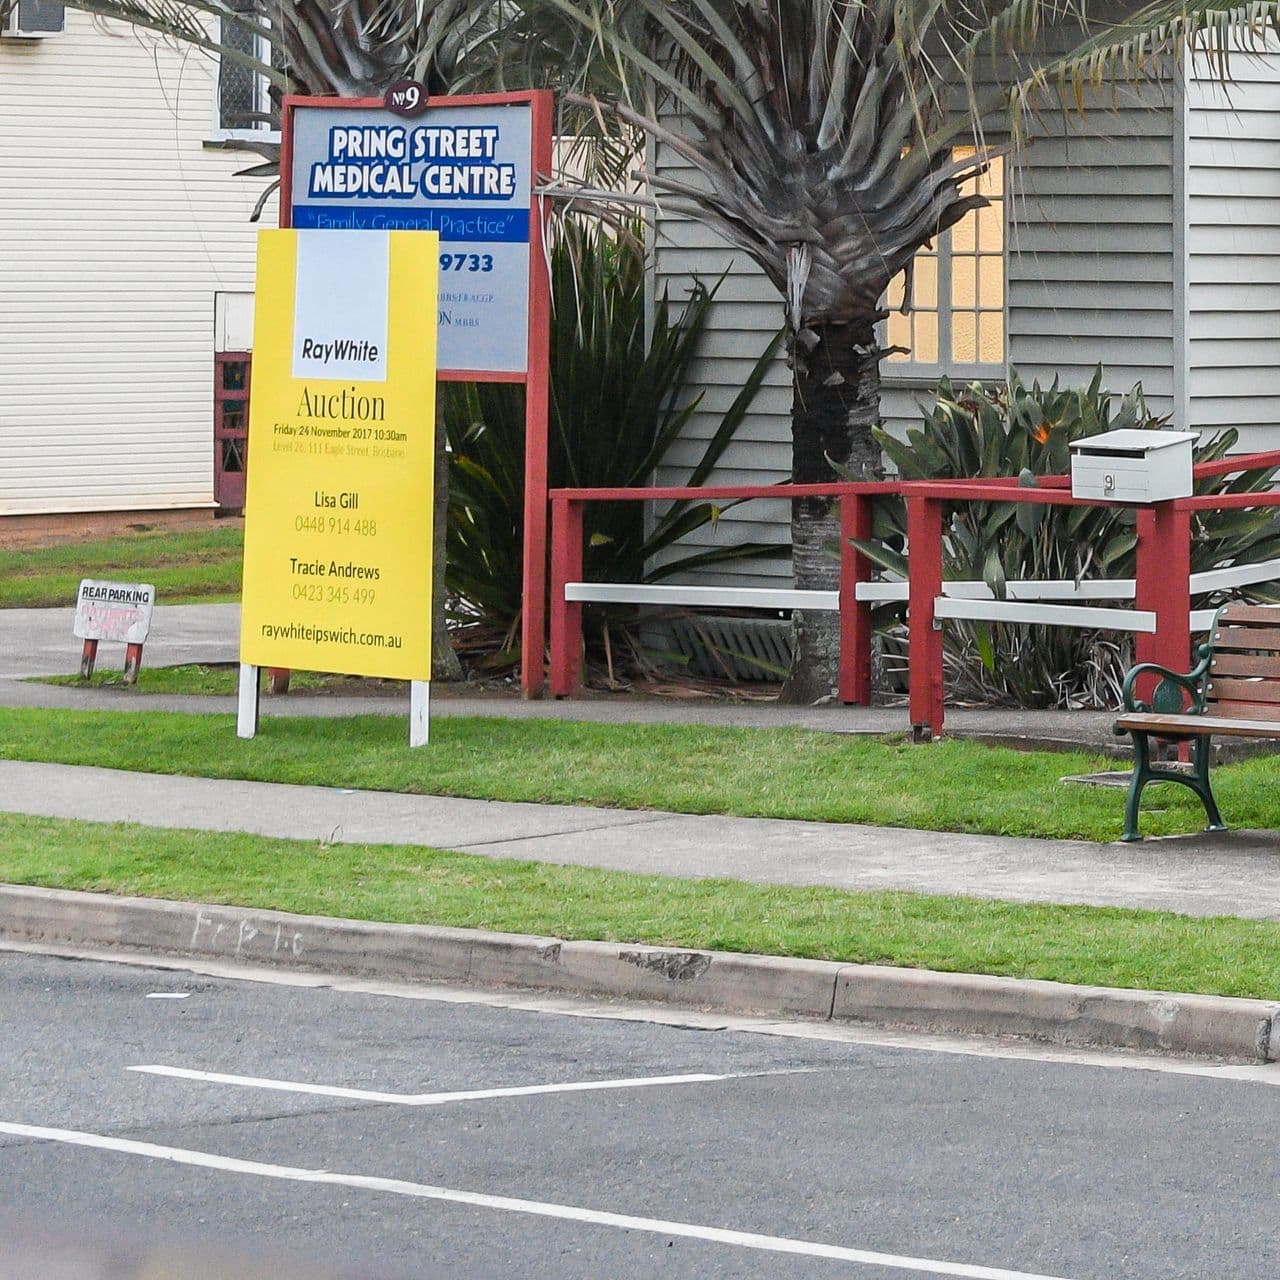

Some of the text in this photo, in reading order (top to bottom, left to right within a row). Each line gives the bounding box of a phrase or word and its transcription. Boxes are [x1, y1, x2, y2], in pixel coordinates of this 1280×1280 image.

[404, 86, 420, 110] 9
[332, 128, 498, 158] PRING STREET
[312, 164, 514, 195] MEDICAL CENTRE
[438, 253, 494, 272] 9733
[296, 385, 385, 421] Auction
[273, 423, 298, 438] Friday
[311, 426, 351, 439] November
[352, 427, 373, 440] 2017
[374, 429, 408, 442] 10:30am
[1105, 474, 1113, 490] 9
[314, 491, 359, 510] Lisa Gill
[294, 515, 378, 537] 0448 914 488
[290, 558, 381, 581] Tracie Andrews
[82, 586, 150, 603] REAR PARKING
[292, 583, 376, 606] 0423 345 499
[261, 622, 403, 649] raywhiteipswich.com.au
